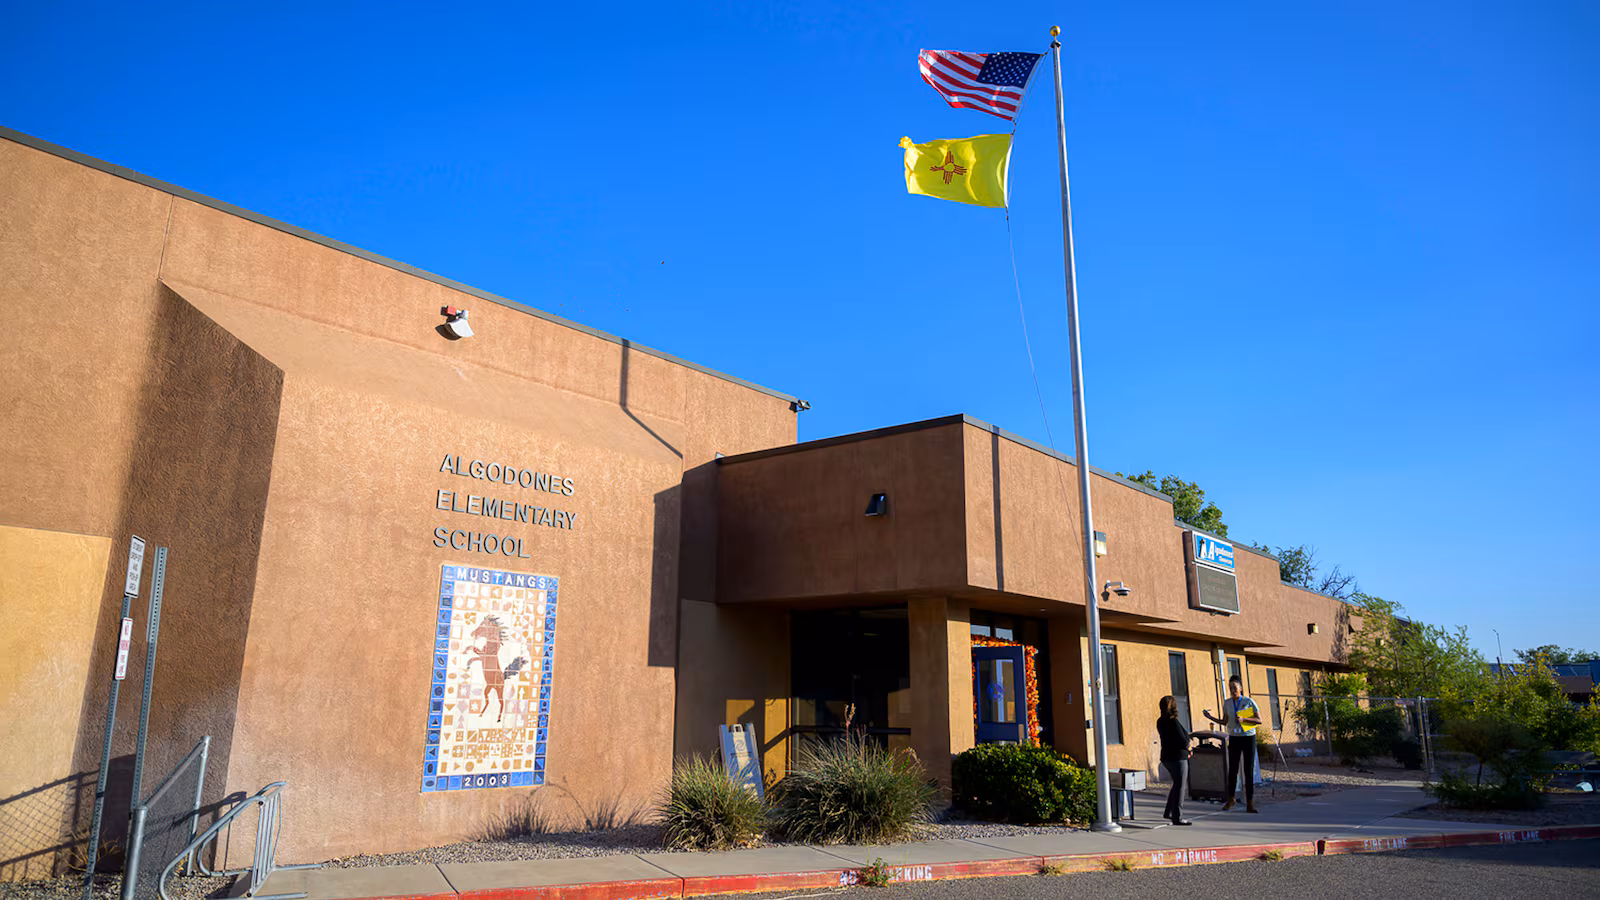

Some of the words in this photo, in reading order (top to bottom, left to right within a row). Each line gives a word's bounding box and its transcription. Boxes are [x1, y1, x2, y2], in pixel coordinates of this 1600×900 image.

[440, 454, 575, 496] ALGODONES
[436, 490, 577, 530] ELEMENTARY
[433, 526, 530, 559] SCHOOL
[457, 567, 546, 589] MUSTANGS
[464, 774, 508, 787] 2003
[1151, 853, 1165, 864] NO
[1175, 849, 1217, 864] PARKING
